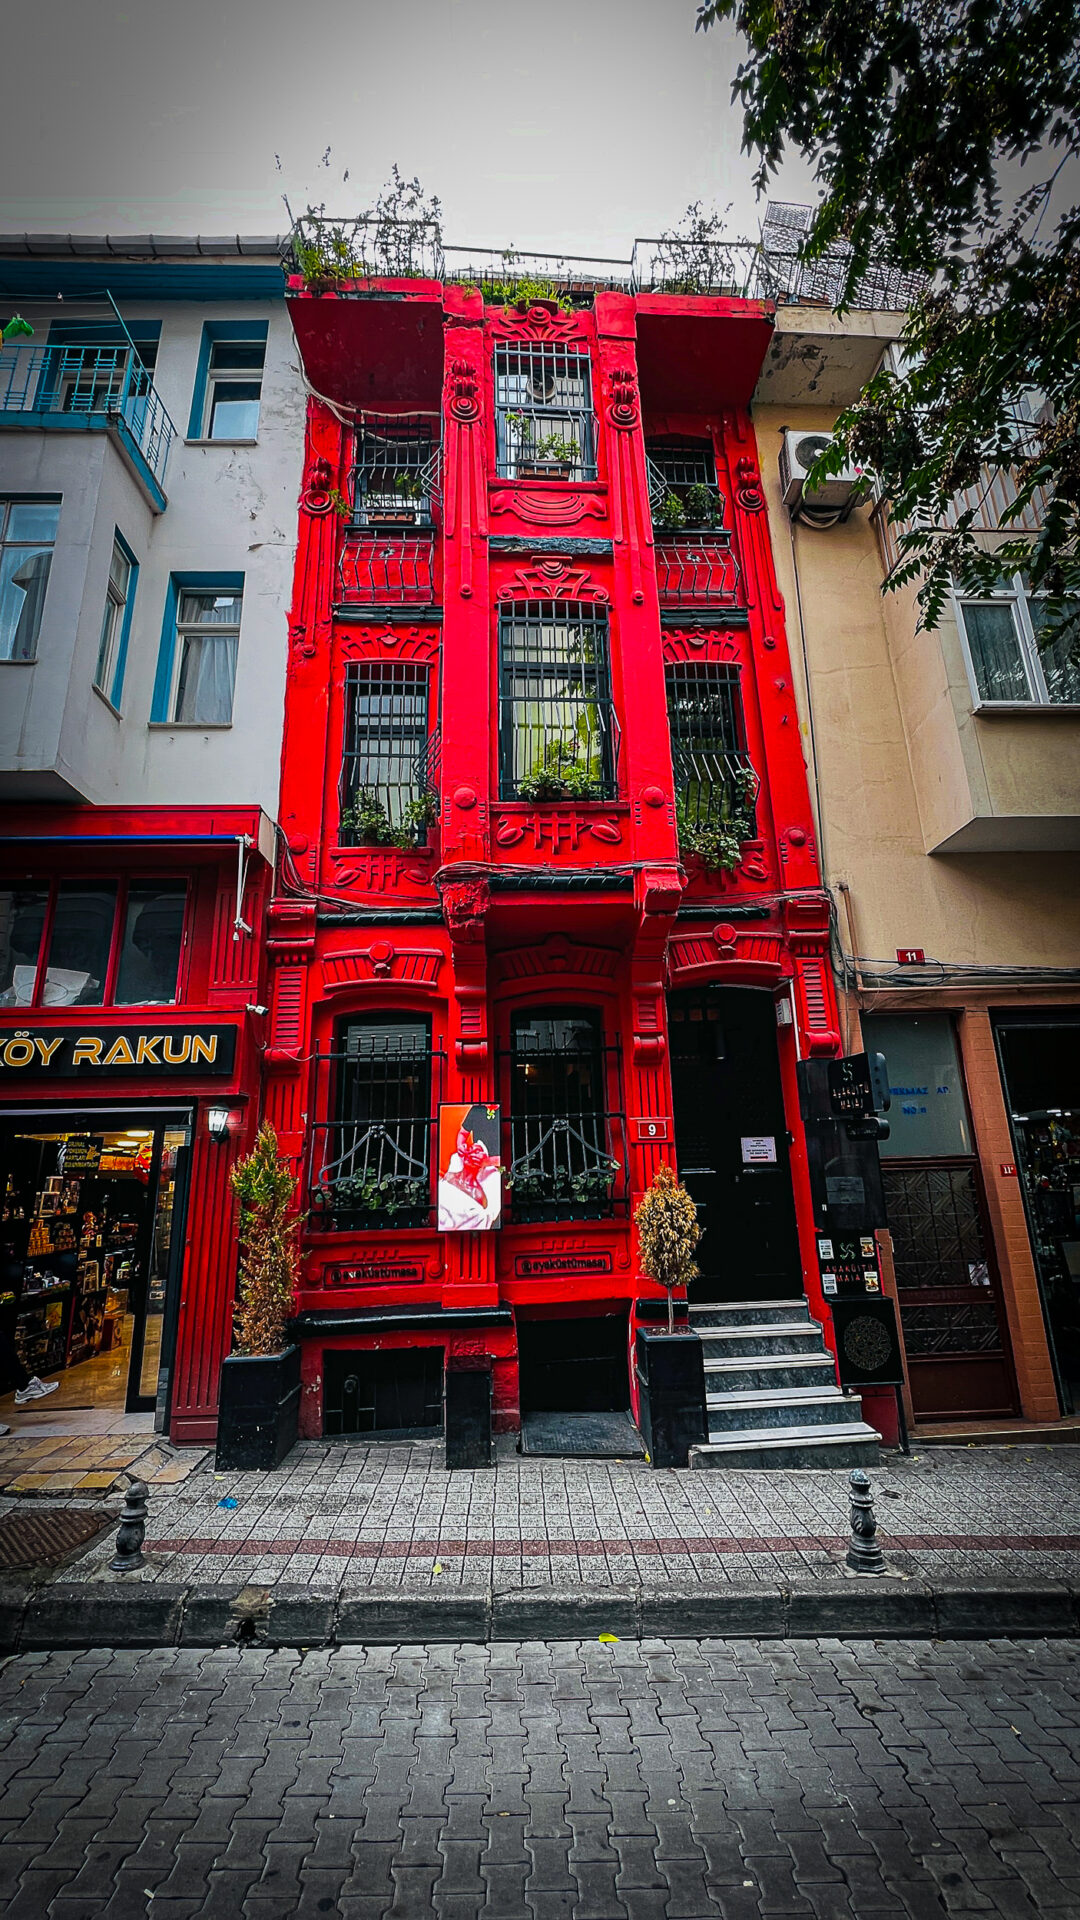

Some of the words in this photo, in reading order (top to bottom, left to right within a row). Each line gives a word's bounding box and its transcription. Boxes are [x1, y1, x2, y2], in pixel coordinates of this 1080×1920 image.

[906, 951, 917, 962] 11
[72, 1035, 218, 1065] RAKUN
[648, 1123, 657, 1136] 9
